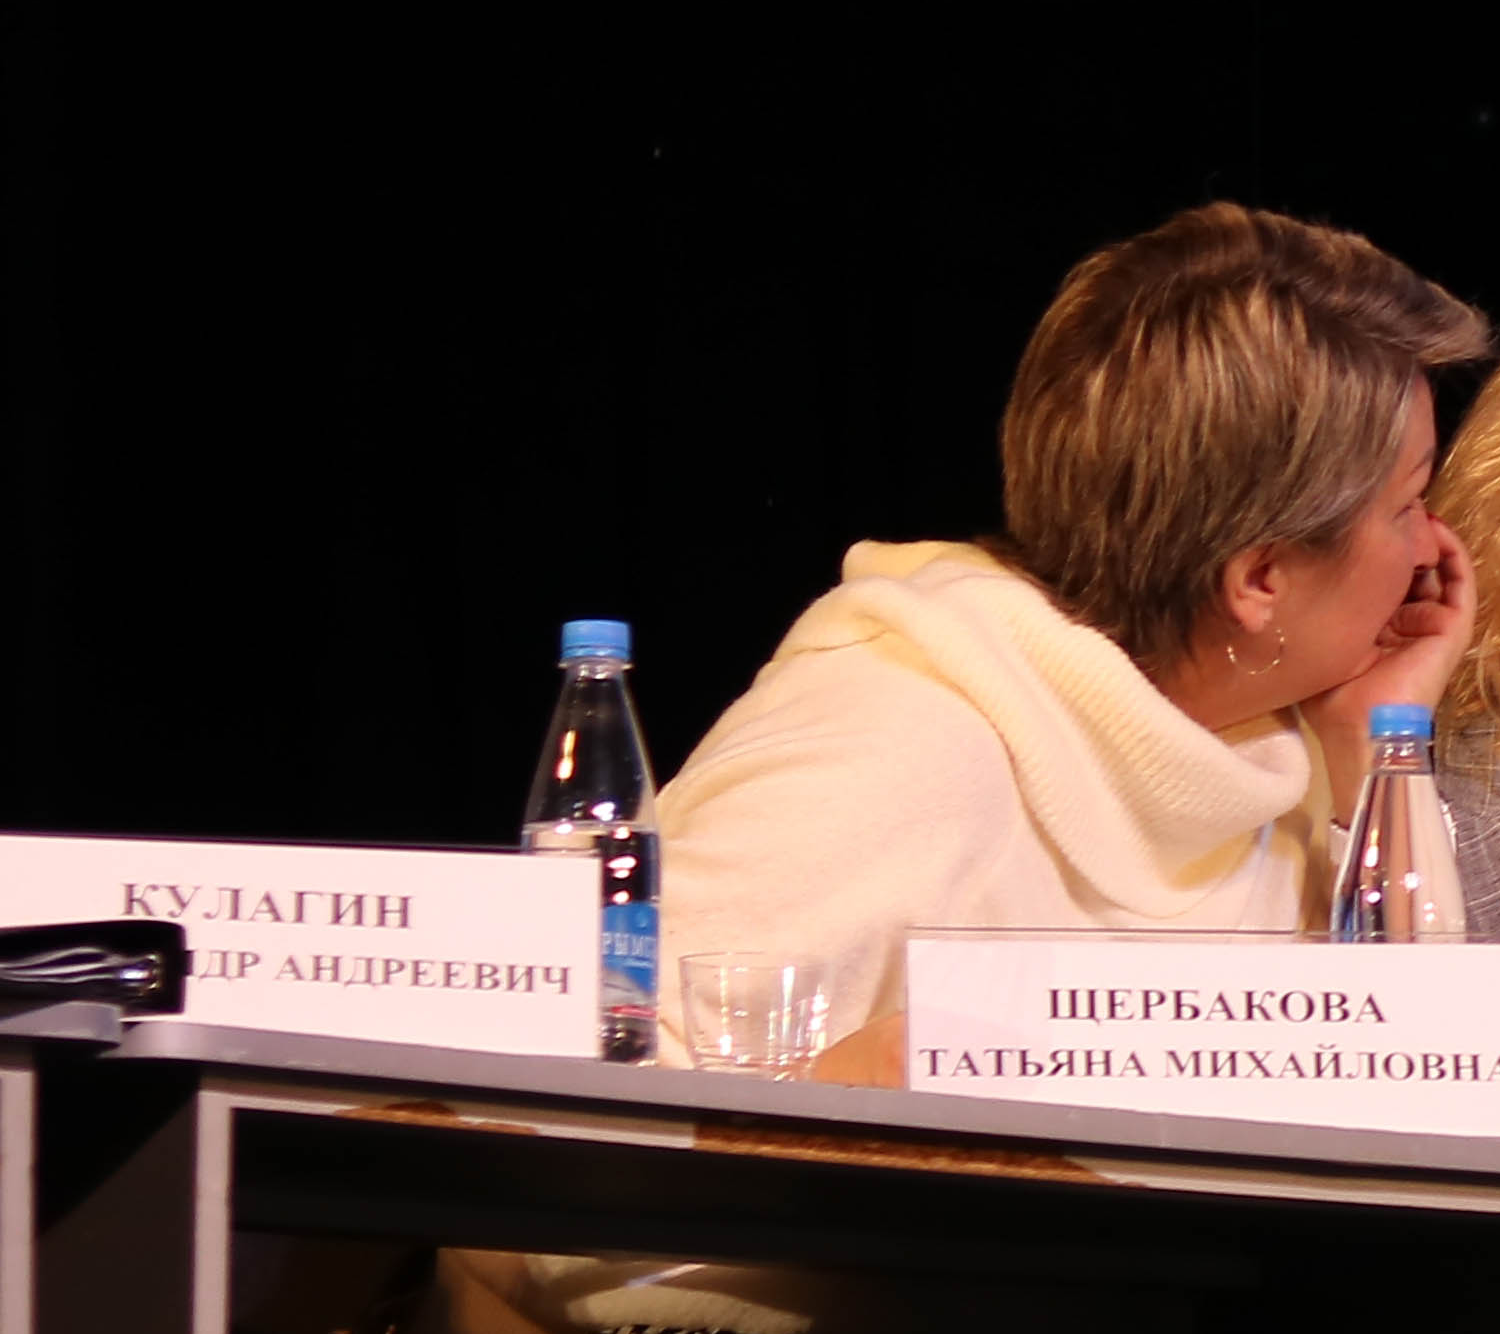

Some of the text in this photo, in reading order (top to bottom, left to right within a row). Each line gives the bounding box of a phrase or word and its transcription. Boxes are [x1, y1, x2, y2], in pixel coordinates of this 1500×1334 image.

[120, 882, 414, 930] КУЛАГИН
[274, 954, 572, 995] АНДРЕЕВИЧ
[1048, 987, 1388, 1025] ЩЕРБАКОВА
[918, 1047, 1148, 1079] ТАТЬЯНА
